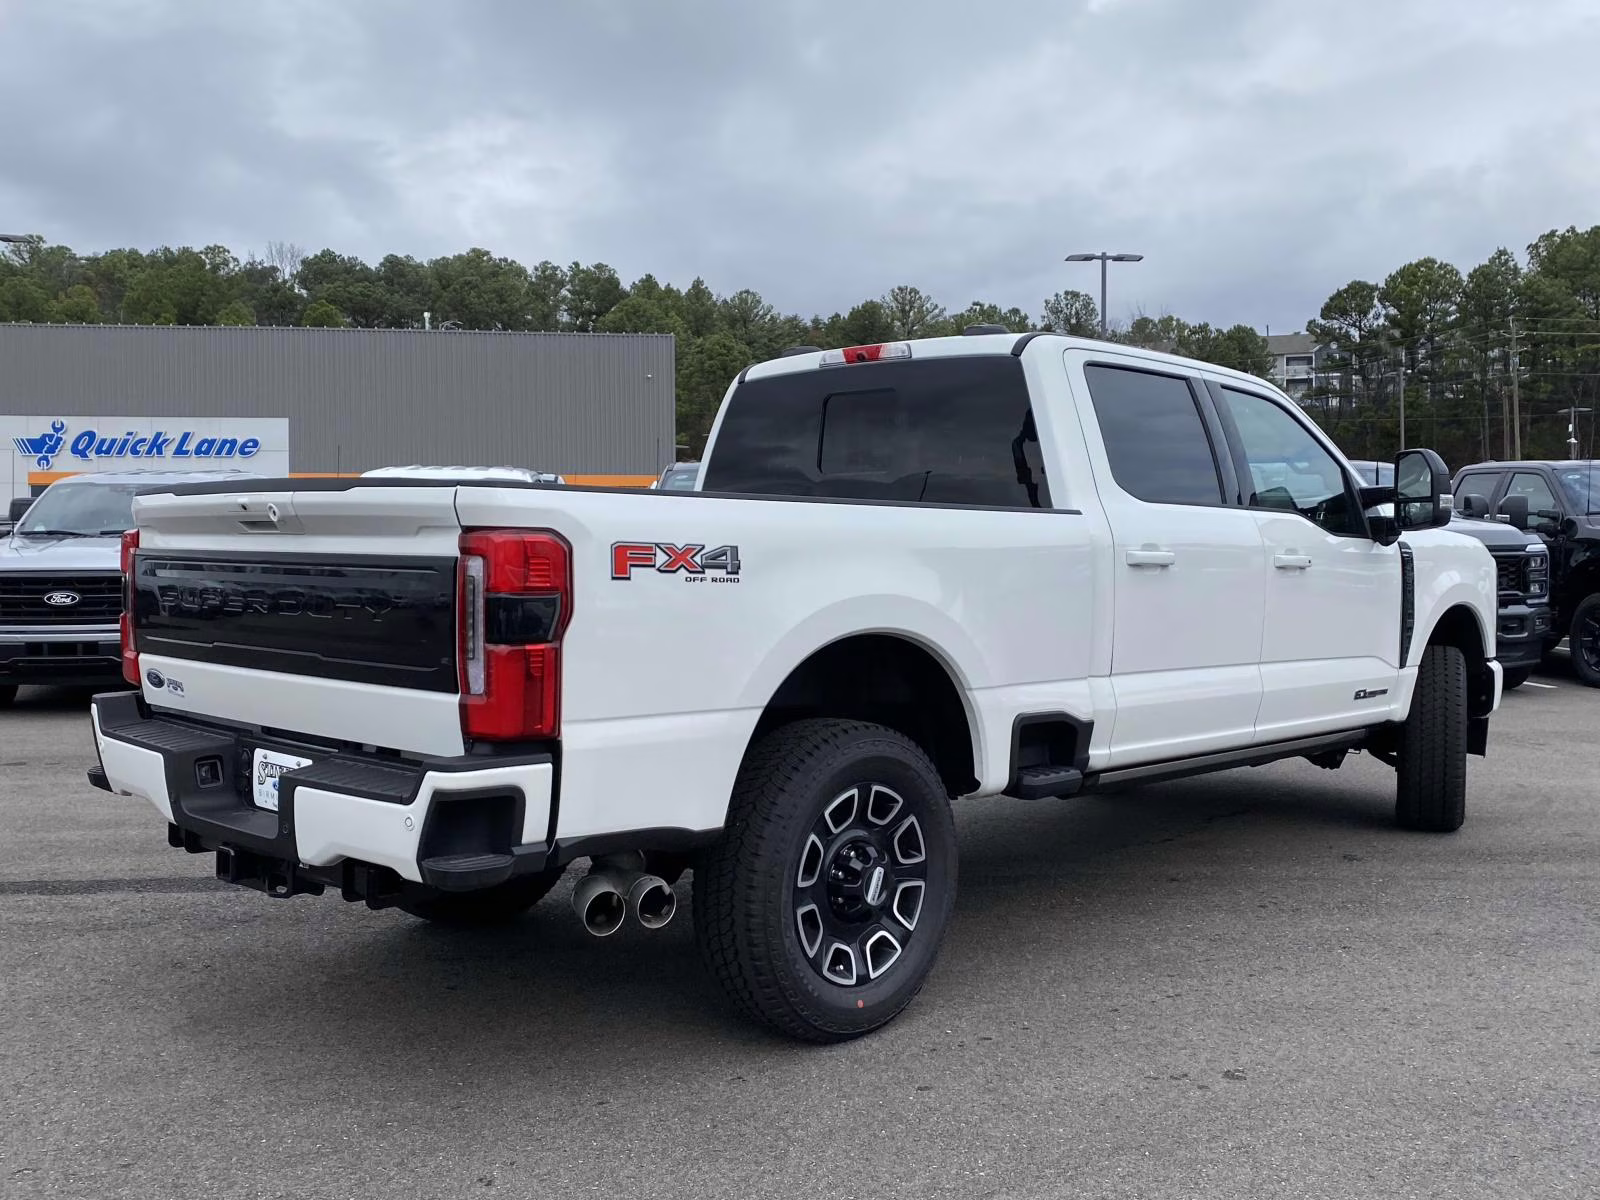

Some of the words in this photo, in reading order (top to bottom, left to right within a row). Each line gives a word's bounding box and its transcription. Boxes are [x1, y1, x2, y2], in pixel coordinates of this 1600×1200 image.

[69, 430, 168, 461] Quick
[172, 431, 260, 458] Lane
[610, 541, 741, 580] FX4
[50, 593, 72, 603] Ford
